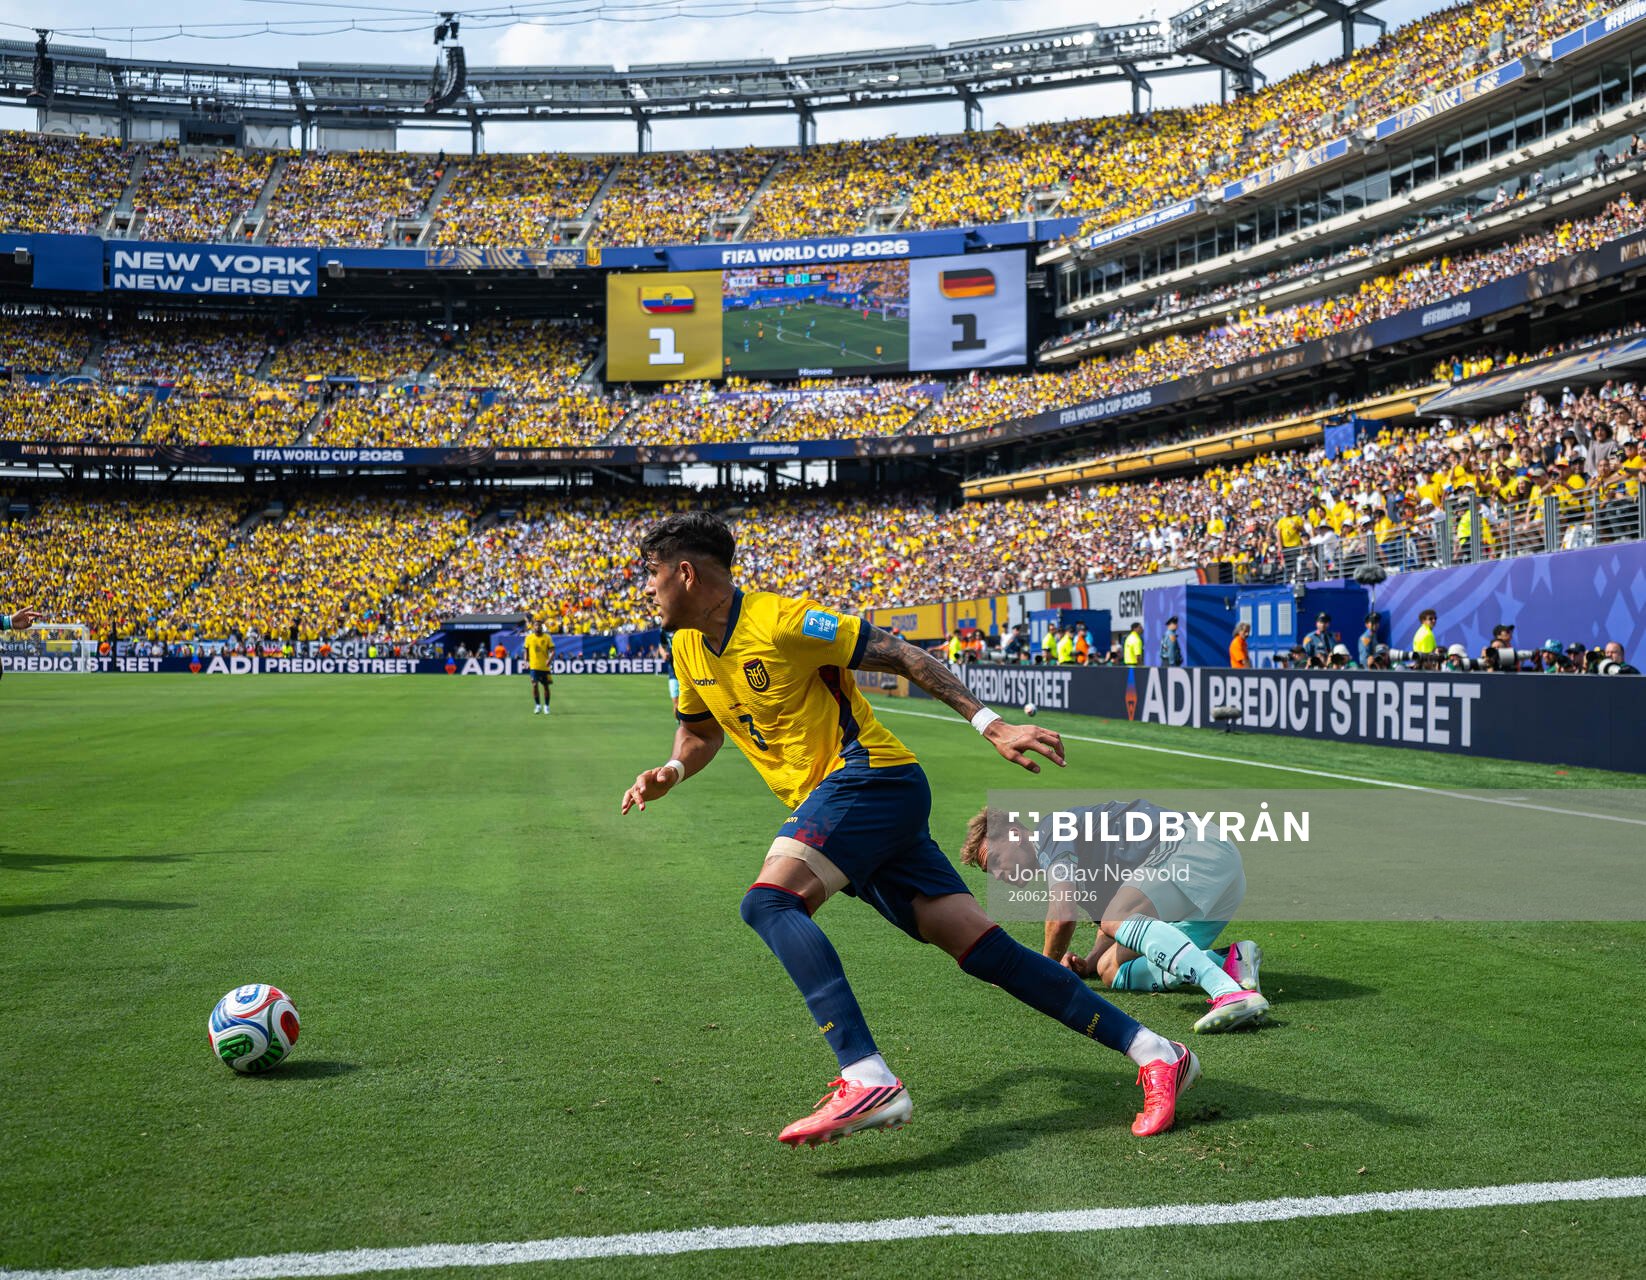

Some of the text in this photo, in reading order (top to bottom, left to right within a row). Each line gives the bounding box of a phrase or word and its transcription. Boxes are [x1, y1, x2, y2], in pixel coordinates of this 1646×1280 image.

[114, 251, 311, 275] NEW YORK
[722, 240, 910, 264] FIFA WORLD CUP 2026
[114, 273, 311, 295] NEW JERSEY
[952, 313, 986, 351] 1
[649, 328, 684, 365] 1
[799, 368, 833, 376] Hisense
[1060, 392, 1151, 425] FIFA WORLD CUP 2026
[253, 449, 404, 461] FIFA WORLD CUP 2026
[206, 656, 420, 674] ADI PREDICTSTREET
[461, 658, 511, 675] ADI
[968, 666, 1072, 709] PREDICTSTREET
[1142, 667, 1481, 747] ADI PREDICTSTREET
